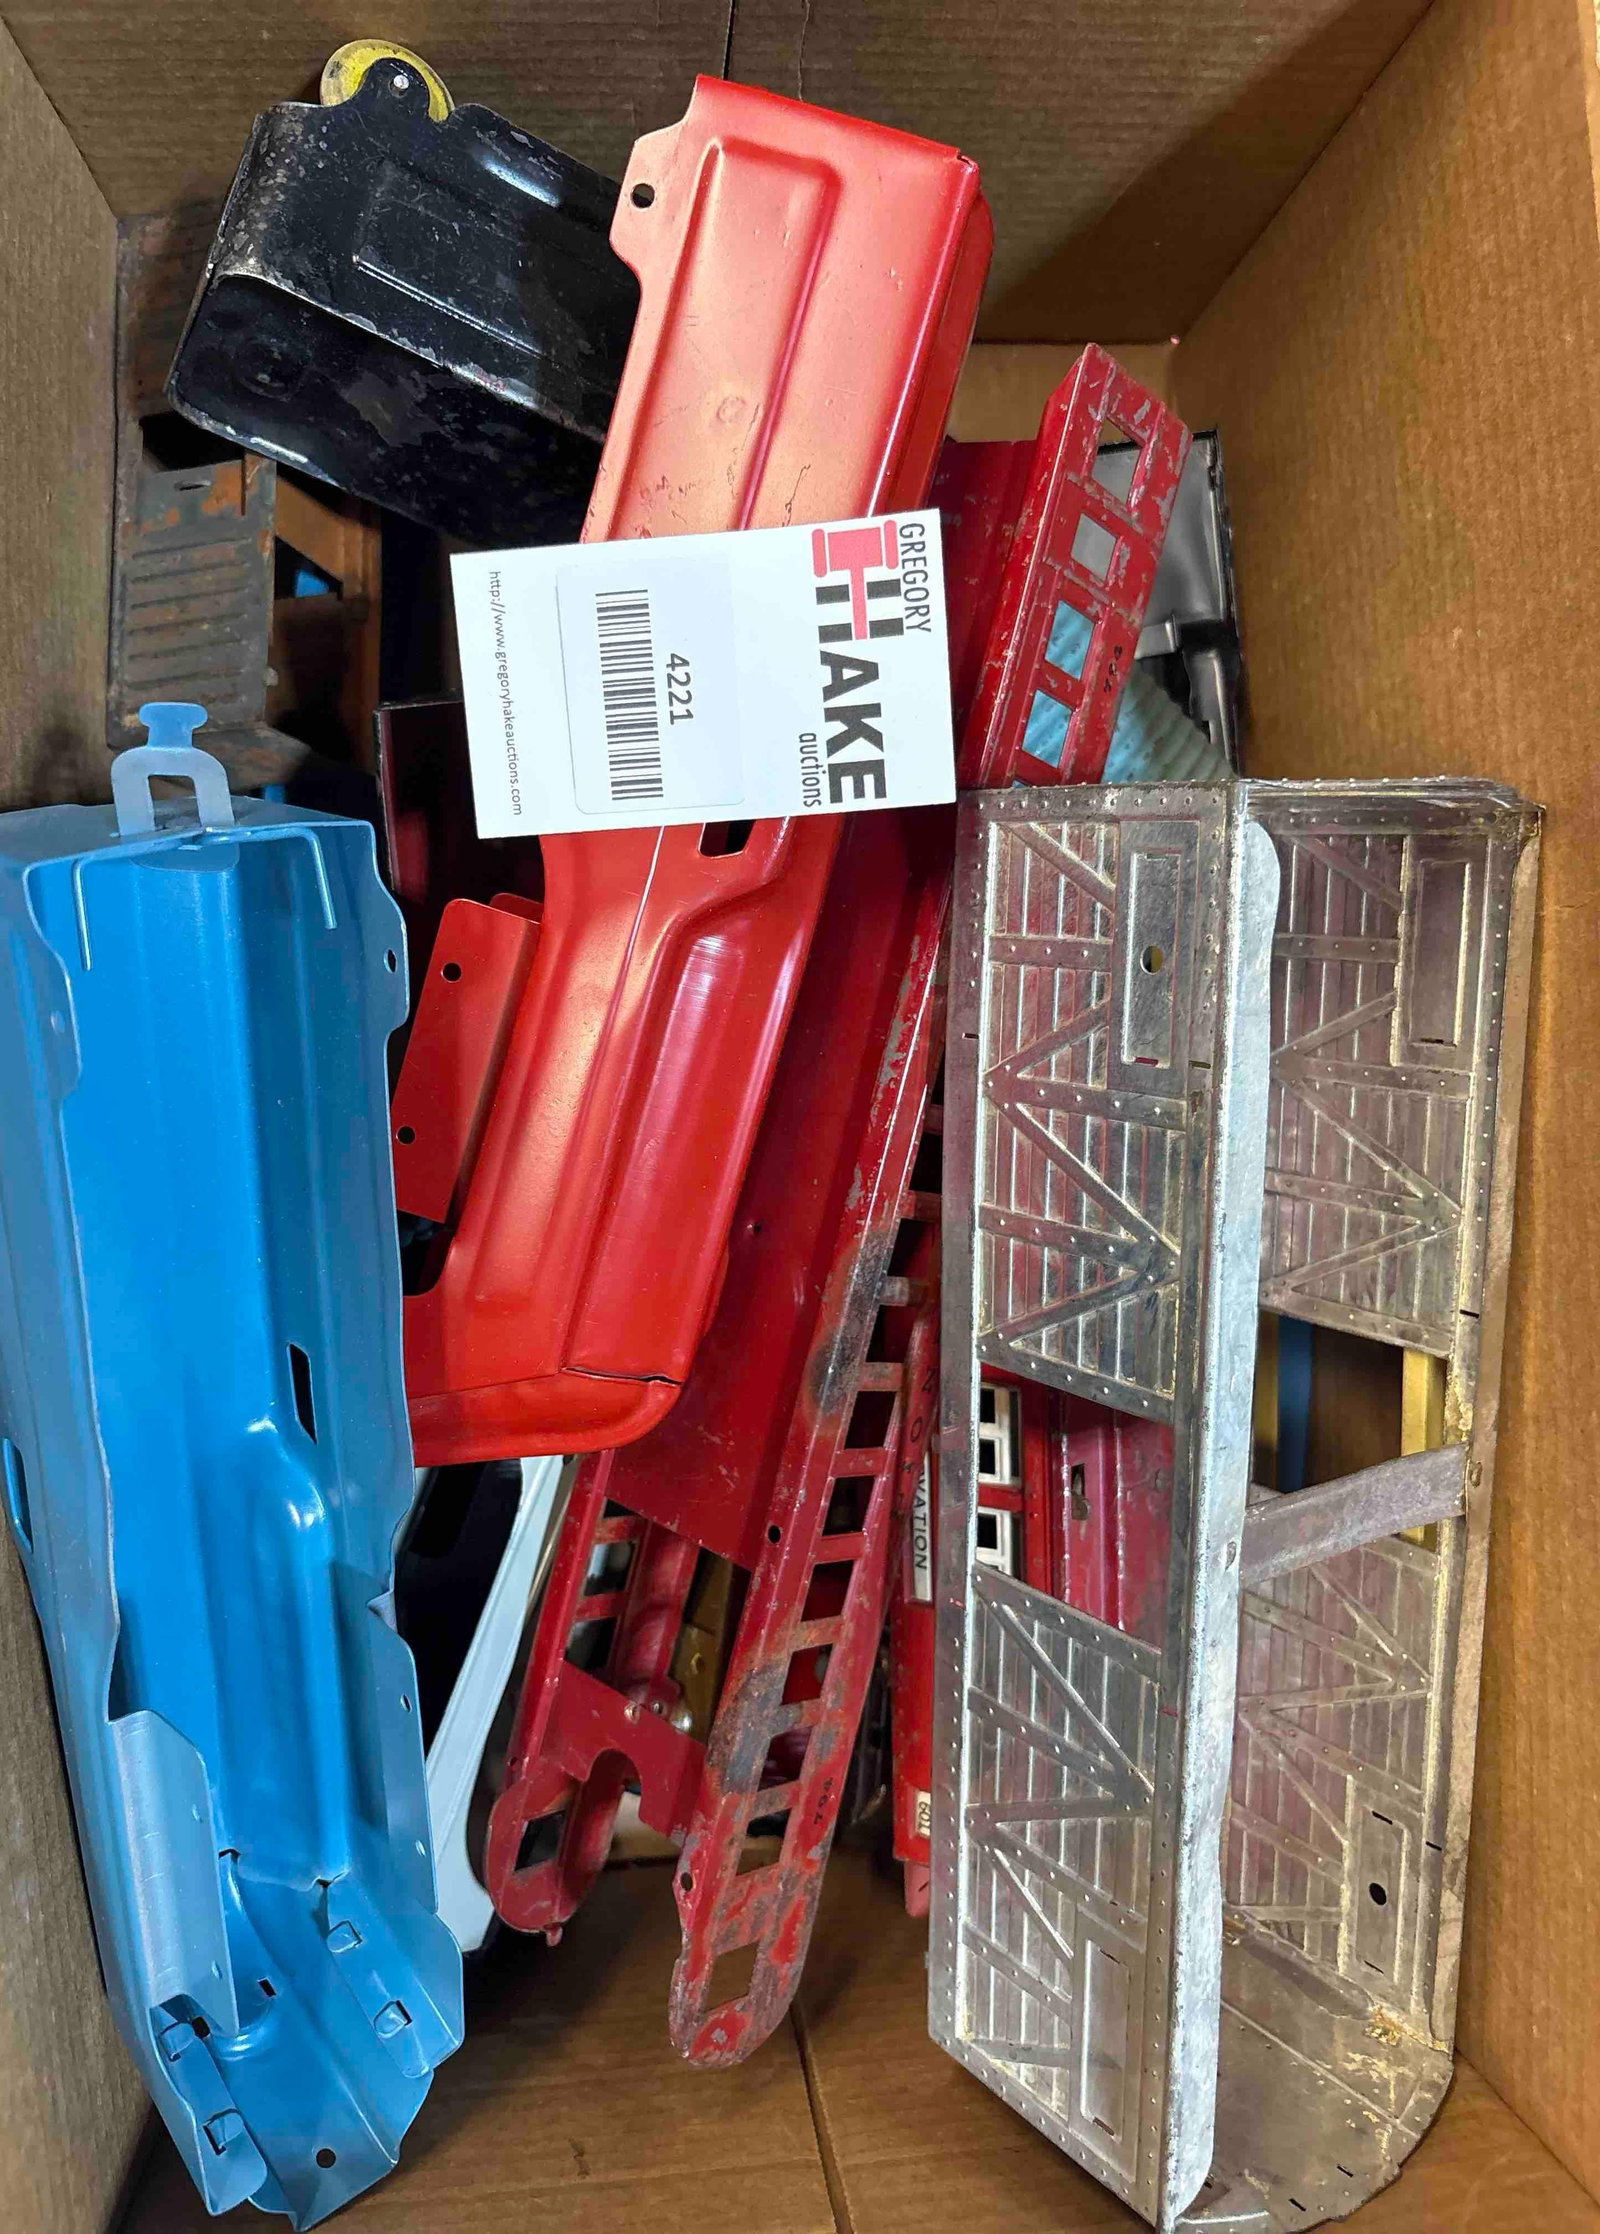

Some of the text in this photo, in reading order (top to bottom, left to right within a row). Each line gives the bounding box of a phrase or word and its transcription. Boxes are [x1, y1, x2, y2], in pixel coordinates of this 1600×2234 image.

[898, 522, 933, 634] GREGORY
[489, 571, 522, 816] http://www.gregoryhakeauctions.com
[666, 653, 694, 725] 4221
[815, 577, 905, 804] HAKE
[798, 732, 823, 809] auctions
[914, 1471, 928, 1570] VATION
